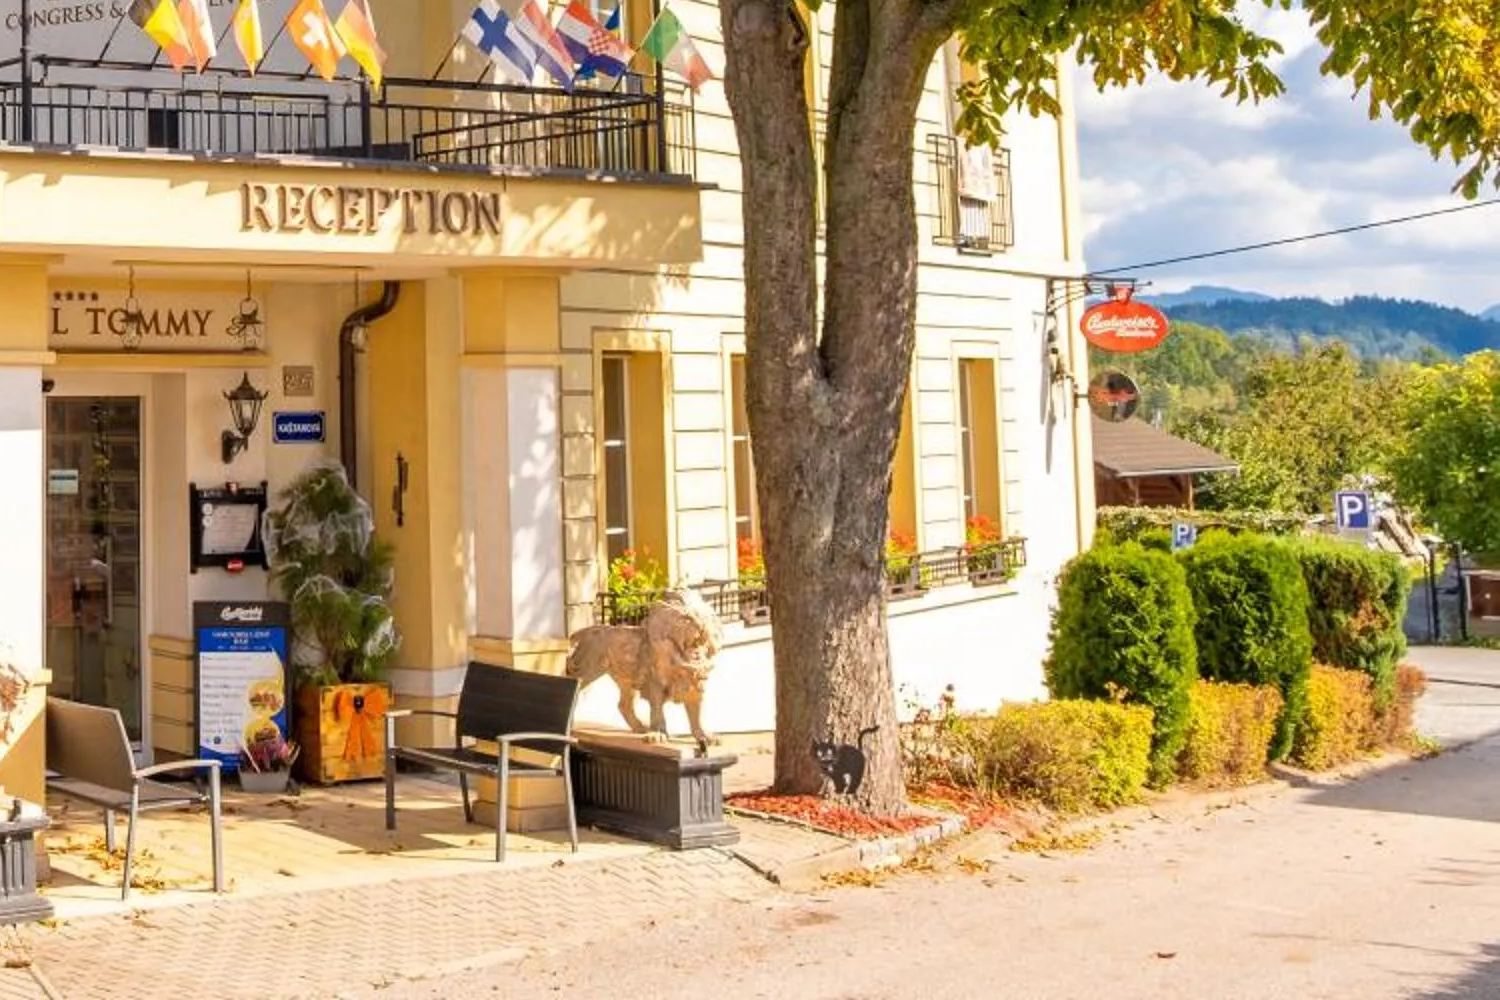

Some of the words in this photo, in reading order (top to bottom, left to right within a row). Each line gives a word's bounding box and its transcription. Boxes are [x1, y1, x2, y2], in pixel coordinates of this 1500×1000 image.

[239, 182, 502, 236] RECEPTION
[85, 307, 214, 337] TOMMY
[1341, 494, 1364, 527] P
